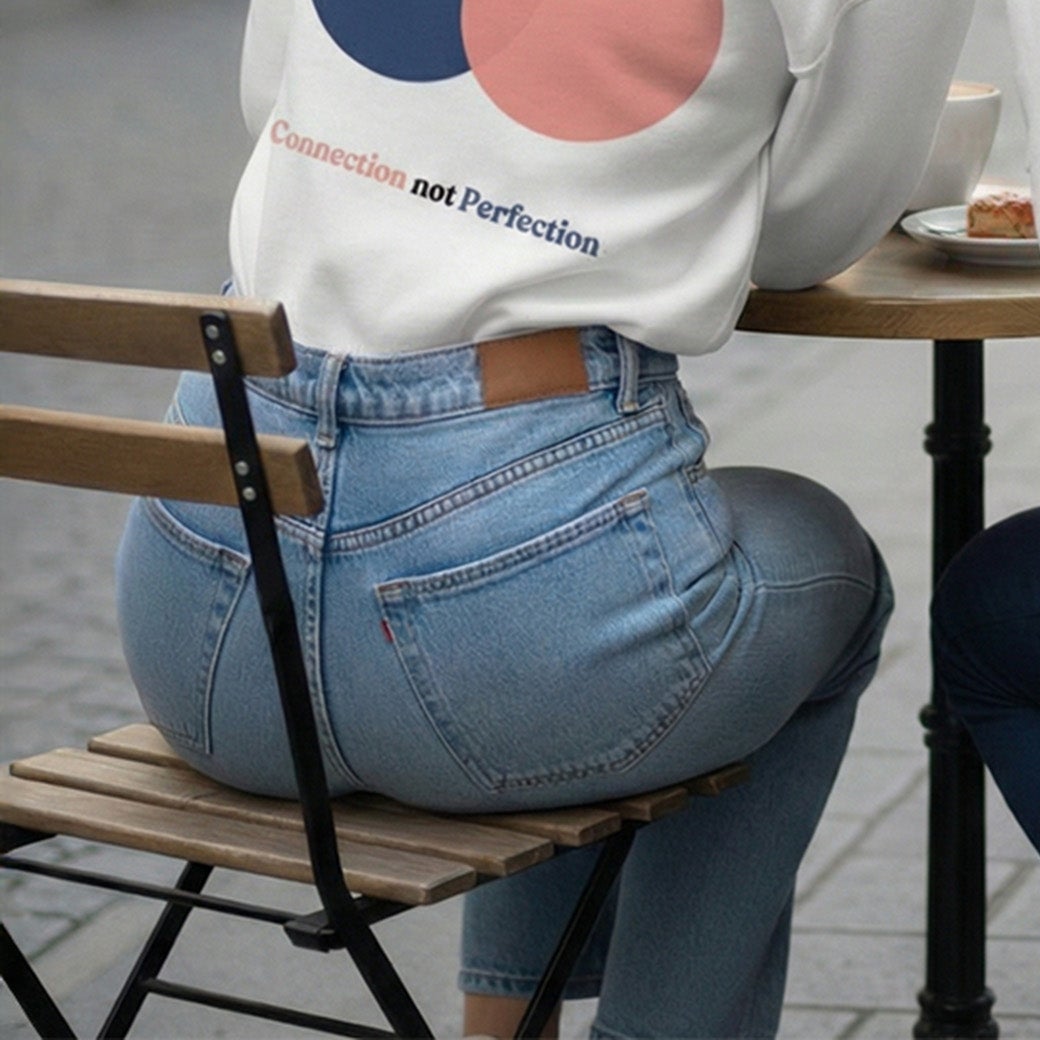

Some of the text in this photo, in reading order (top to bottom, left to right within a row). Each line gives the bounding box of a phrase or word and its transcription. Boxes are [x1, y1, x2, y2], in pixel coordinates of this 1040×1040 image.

[269, 119, 600, 257] Connection not Perfection
